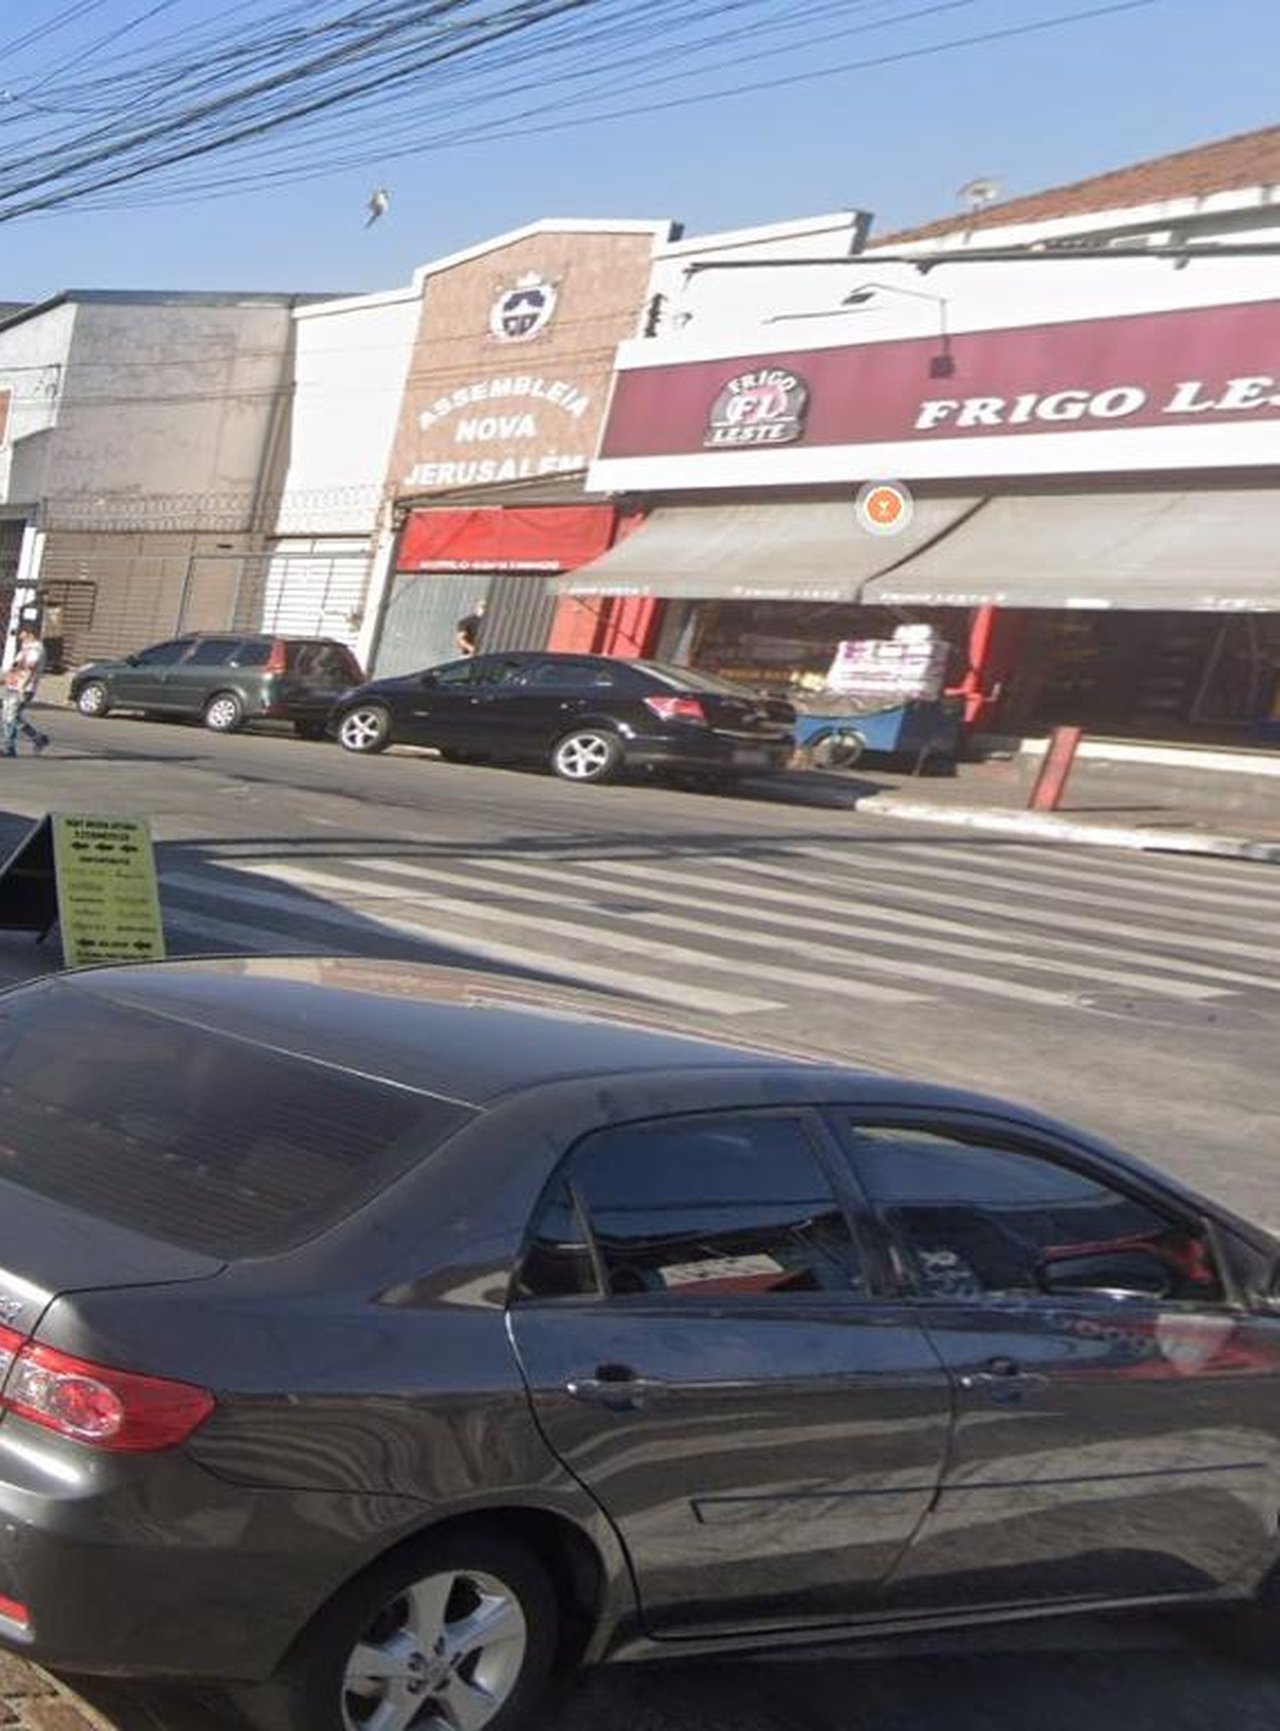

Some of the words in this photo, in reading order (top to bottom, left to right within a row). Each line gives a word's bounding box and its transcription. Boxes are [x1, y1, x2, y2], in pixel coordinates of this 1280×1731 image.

[728, 369, 798, 396] FRIGO
[418, 375, 590, 431] ASSEMBLEIA
[913, 386, 1147, 430] FRIGO
[1161, 376, 1280, 414] LE
[454, 412, 538, 443] NOVA
[712, 423, 786, 443] LESTE
[403, 448, 585, 487] JERUSALÉM
